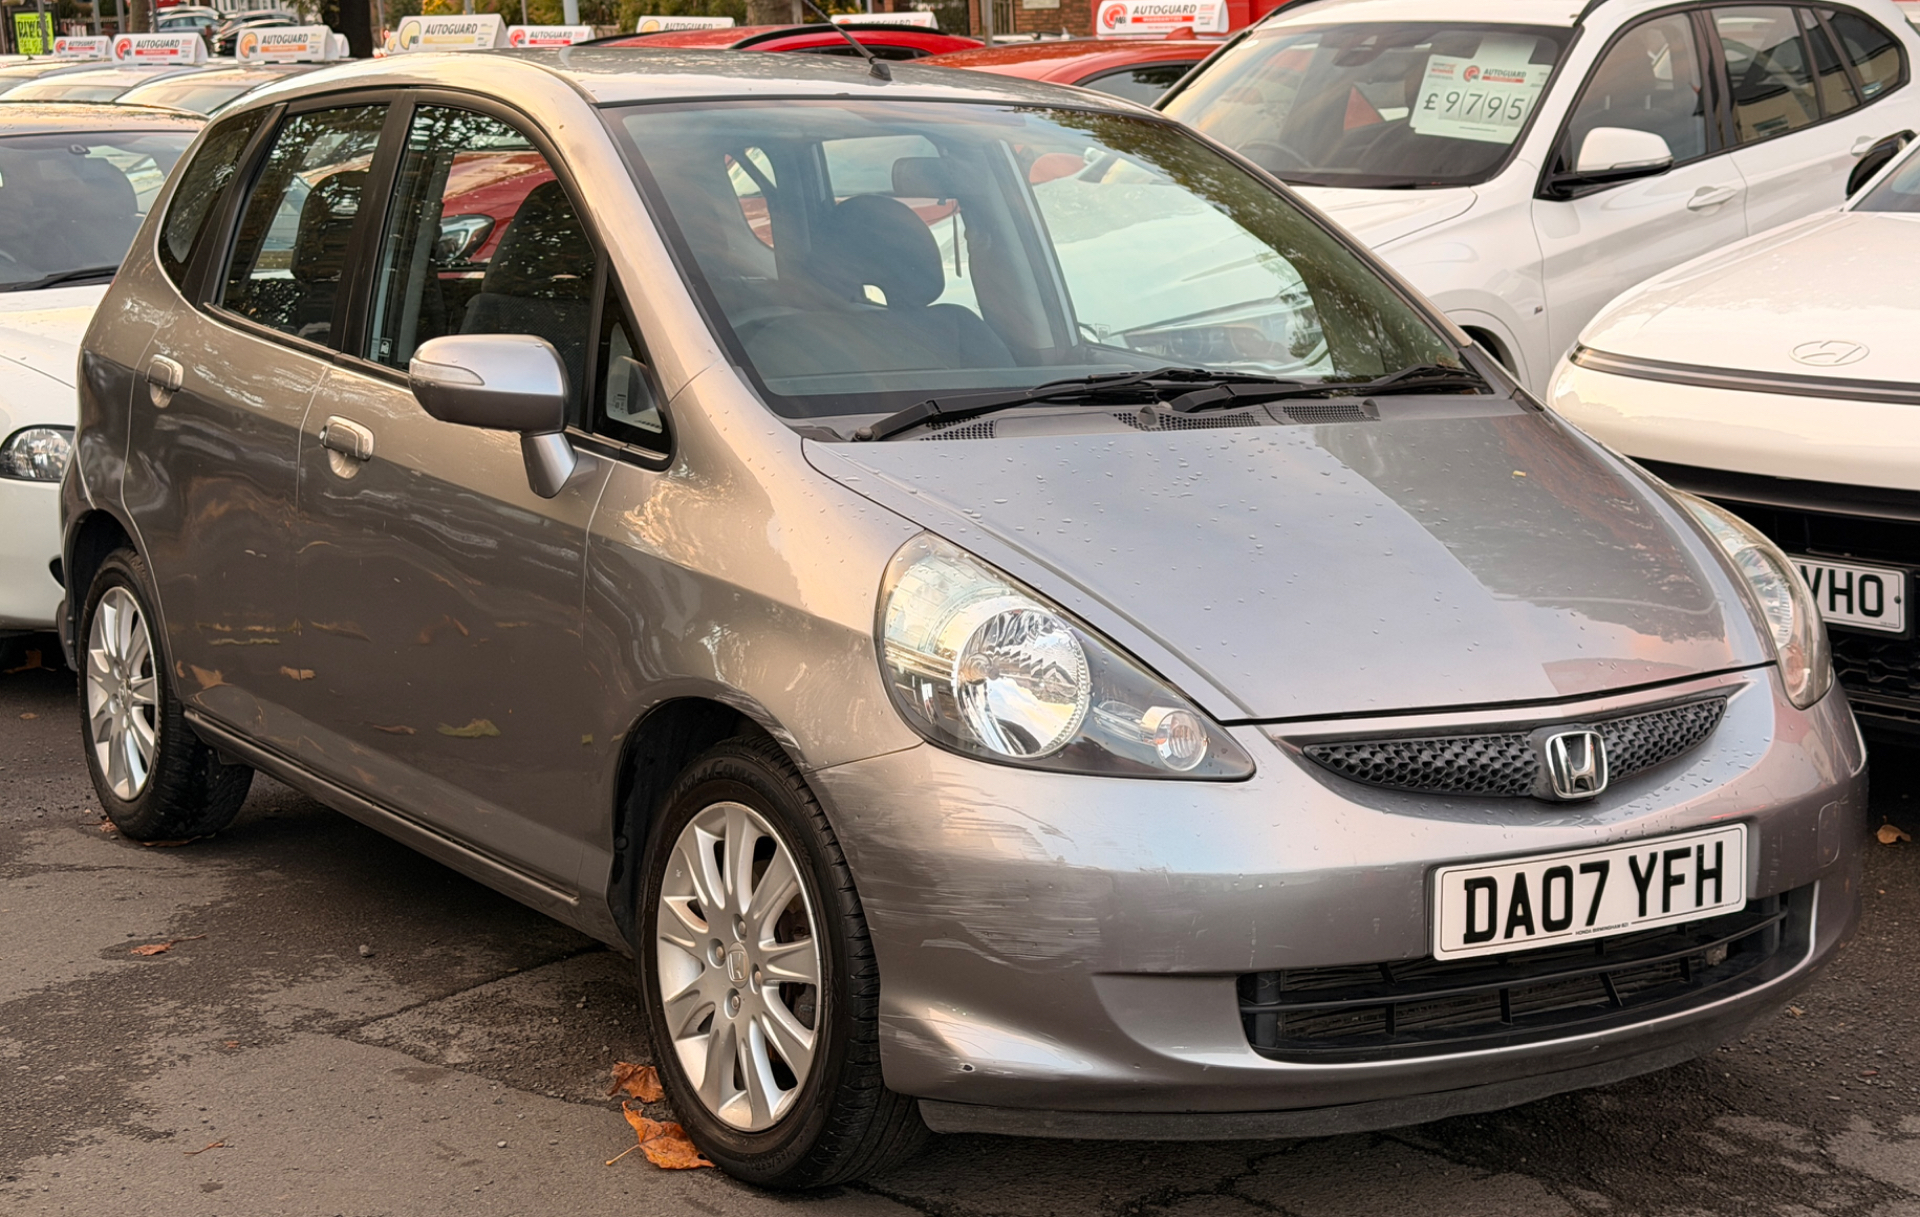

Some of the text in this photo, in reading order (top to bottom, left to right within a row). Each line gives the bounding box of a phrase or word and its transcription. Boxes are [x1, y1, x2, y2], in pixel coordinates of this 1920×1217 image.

[1133, 4, 1197, 15] AUTOGUARD
[425, 23, 478, 34] AUTOGUARD
[530, 30, 573, 38] AUTOGUARD
[136, 39, 180, 48] AUTOGUARD
[261, 33, 308, 44] AUTOGUARD
[1484, 68, 1527, 78] AUTOGUARD
[1423, 91, 1526, 120] £9795
[1800, 565, 1884, 618] VHO
[1463, 840, 1723, 945] DA07 YFH
